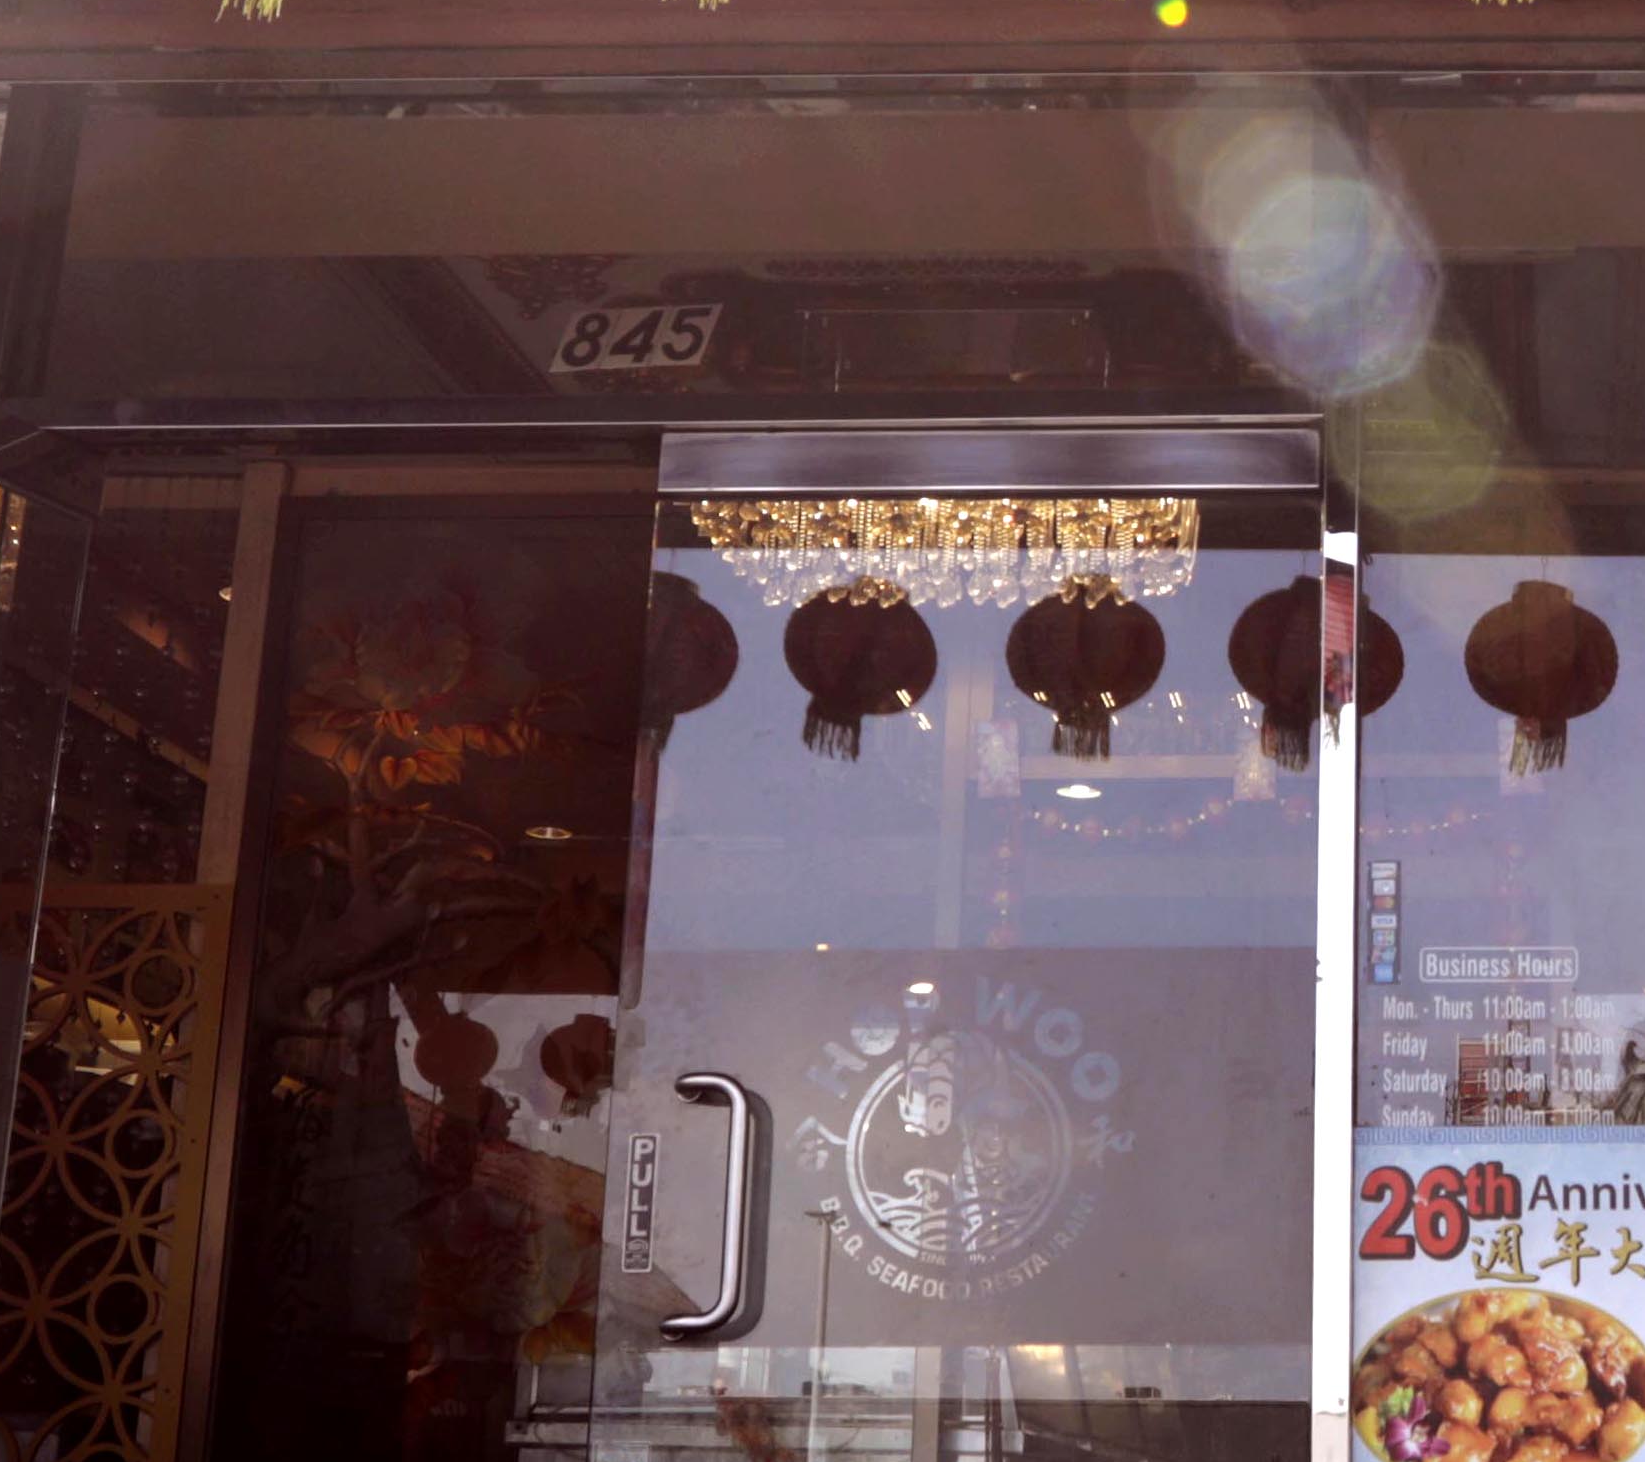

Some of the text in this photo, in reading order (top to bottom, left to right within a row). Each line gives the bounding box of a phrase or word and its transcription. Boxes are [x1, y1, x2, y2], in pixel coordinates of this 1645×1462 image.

[560, 306, 713, 369] 845
[1425, 953, 1574, 977] Business Hours
[1382, 996, 1616, 1019] Mon. Thurs 11:00am 1:00am
[976, 975, 1121, 1101] WOO
[1382, 1033, 1545, 1061] Friday 11:00am
[1383, 1069, 1545, 1095] Saturday 10:00am
[1382, 1105, 1435, 1125] Sunday
[629, 1138, 654, 1237] PULL
[1359, 1161, 1521, 1261] 26th
